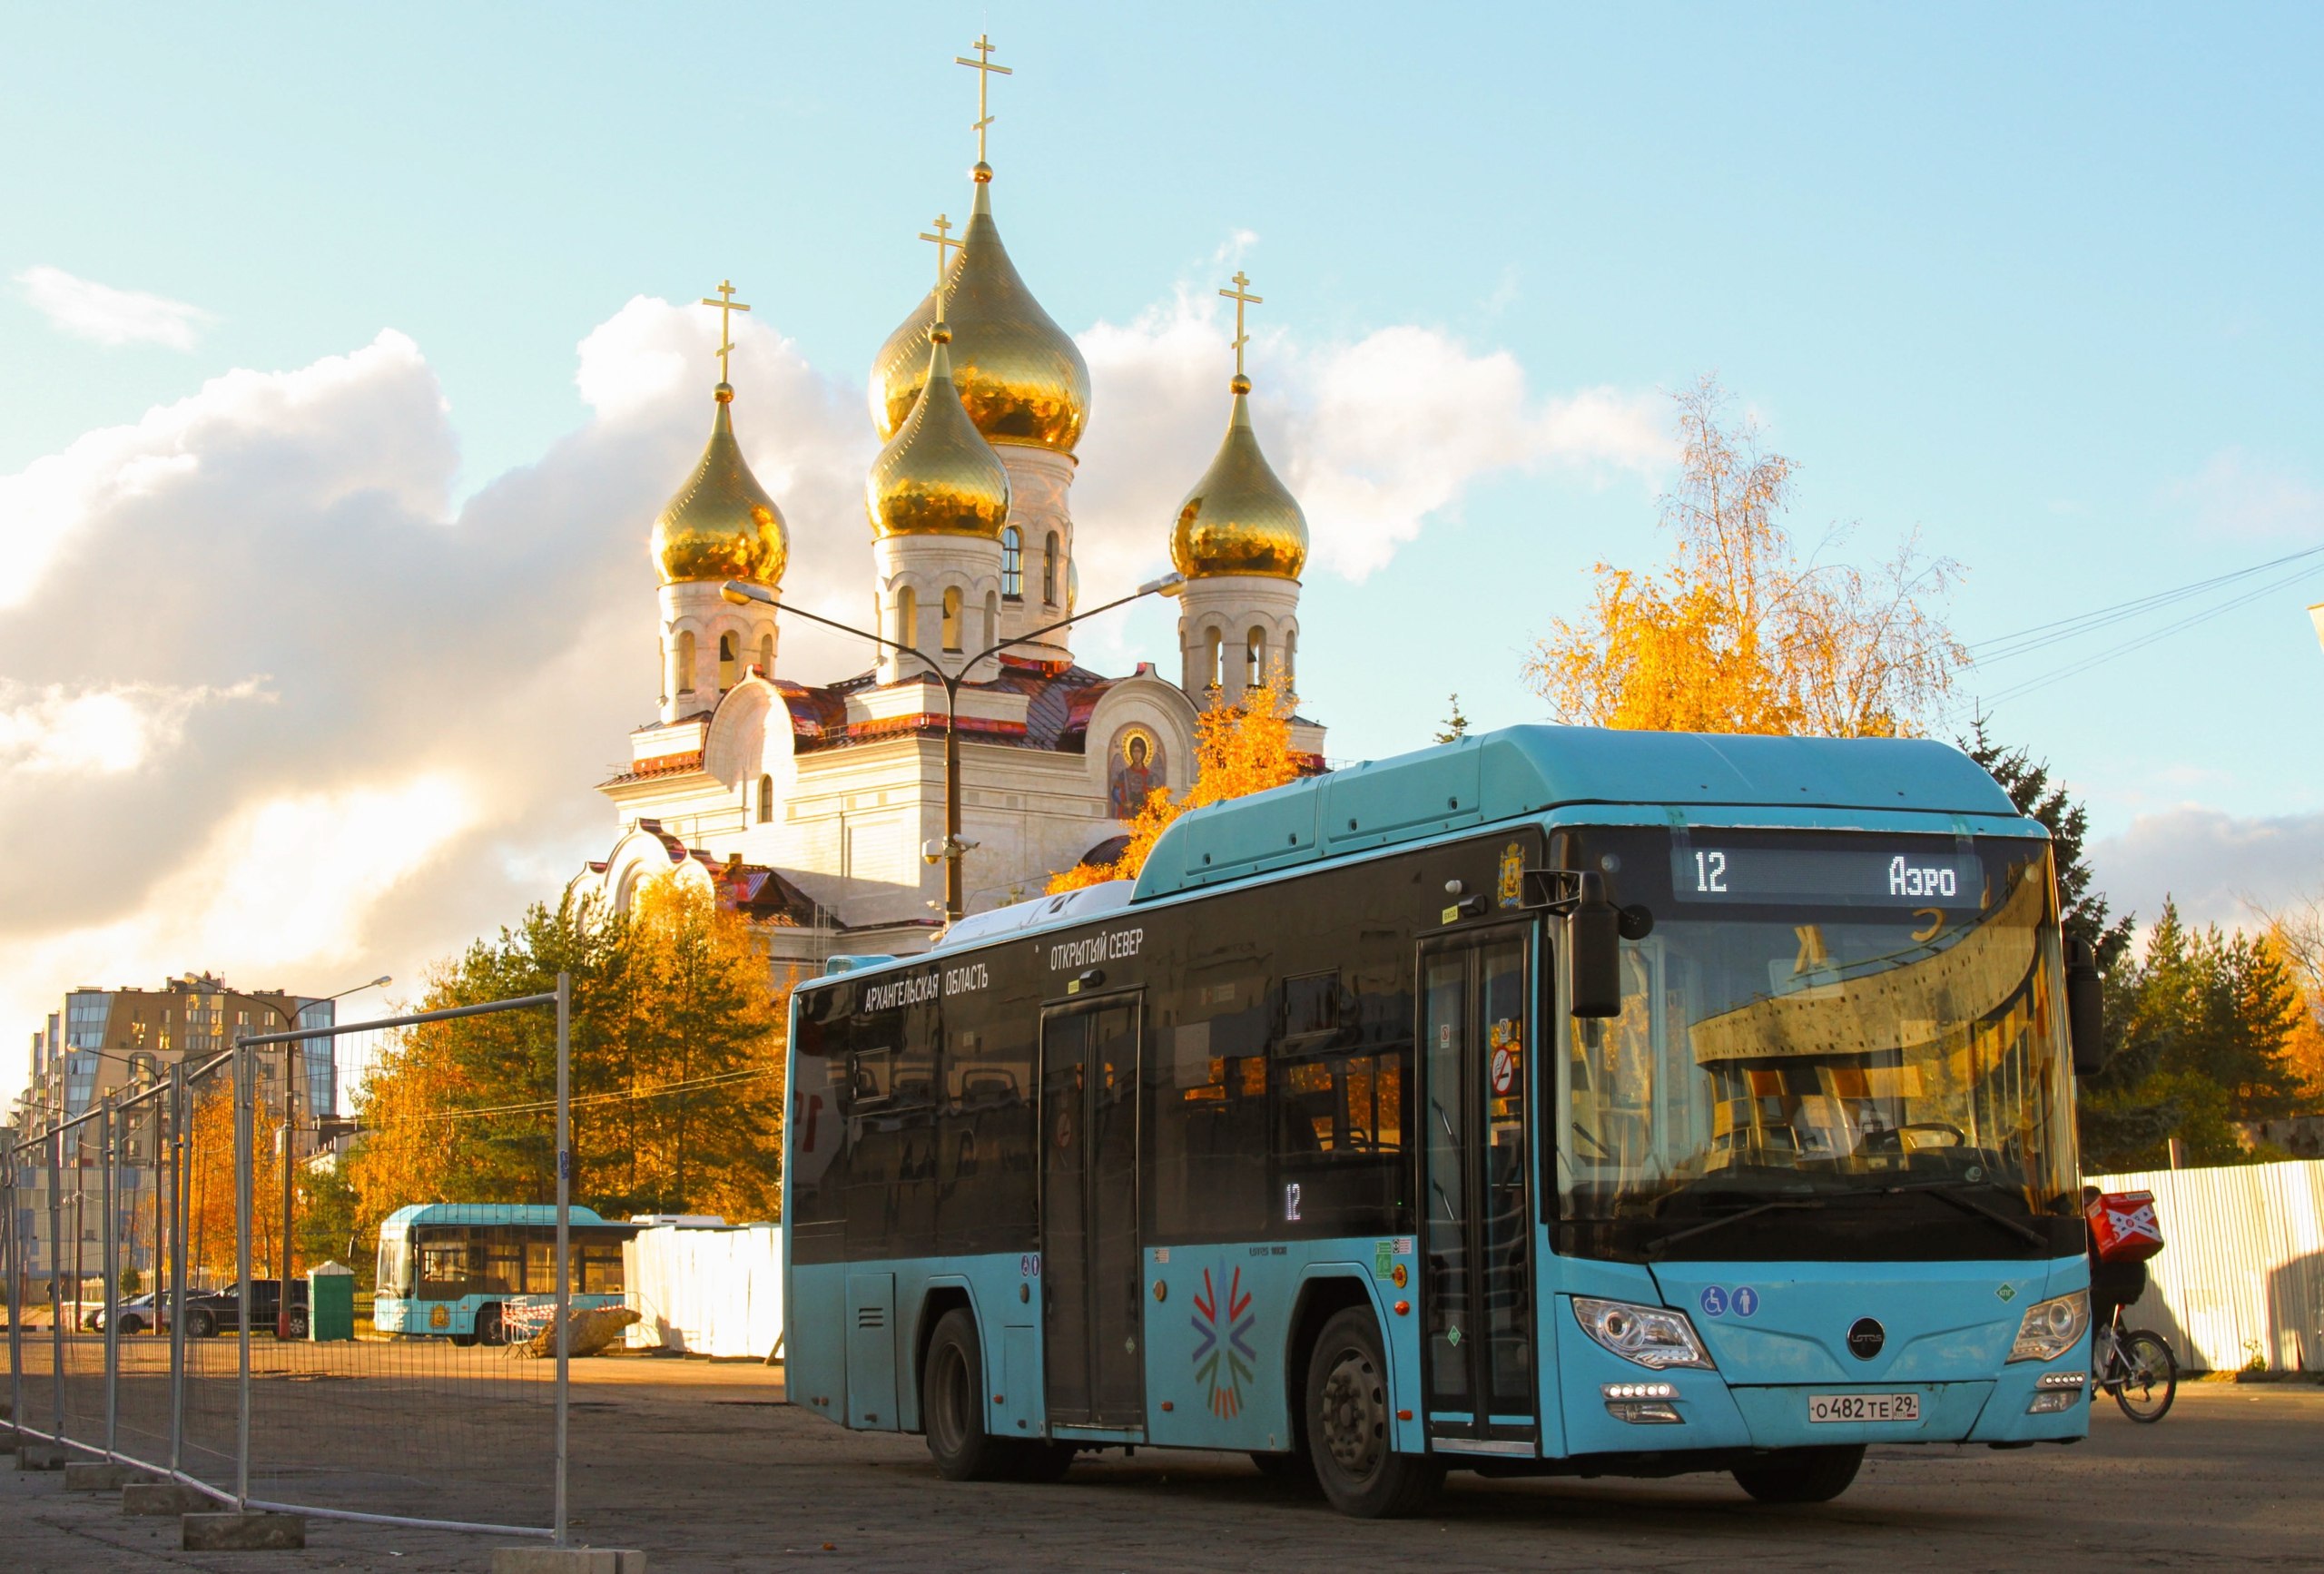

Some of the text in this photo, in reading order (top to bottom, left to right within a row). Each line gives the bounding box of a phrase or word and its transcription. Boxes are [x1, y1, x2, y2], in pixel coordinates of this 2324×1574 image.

[1696, 851, 1727, 892] 12
[1889, 856, 1956, 897] Аэро
[1050, 928, 1143, 971] ОТКРЫТЫЙ СЕВЕР
[865, 963, 989, 1013] АРХАНГЕЛЬСКАЯ ОБЛАСТЬ
[1286, 1183, 1301, 1221] 12
[1895, 1396, 1912, 1412] 29
